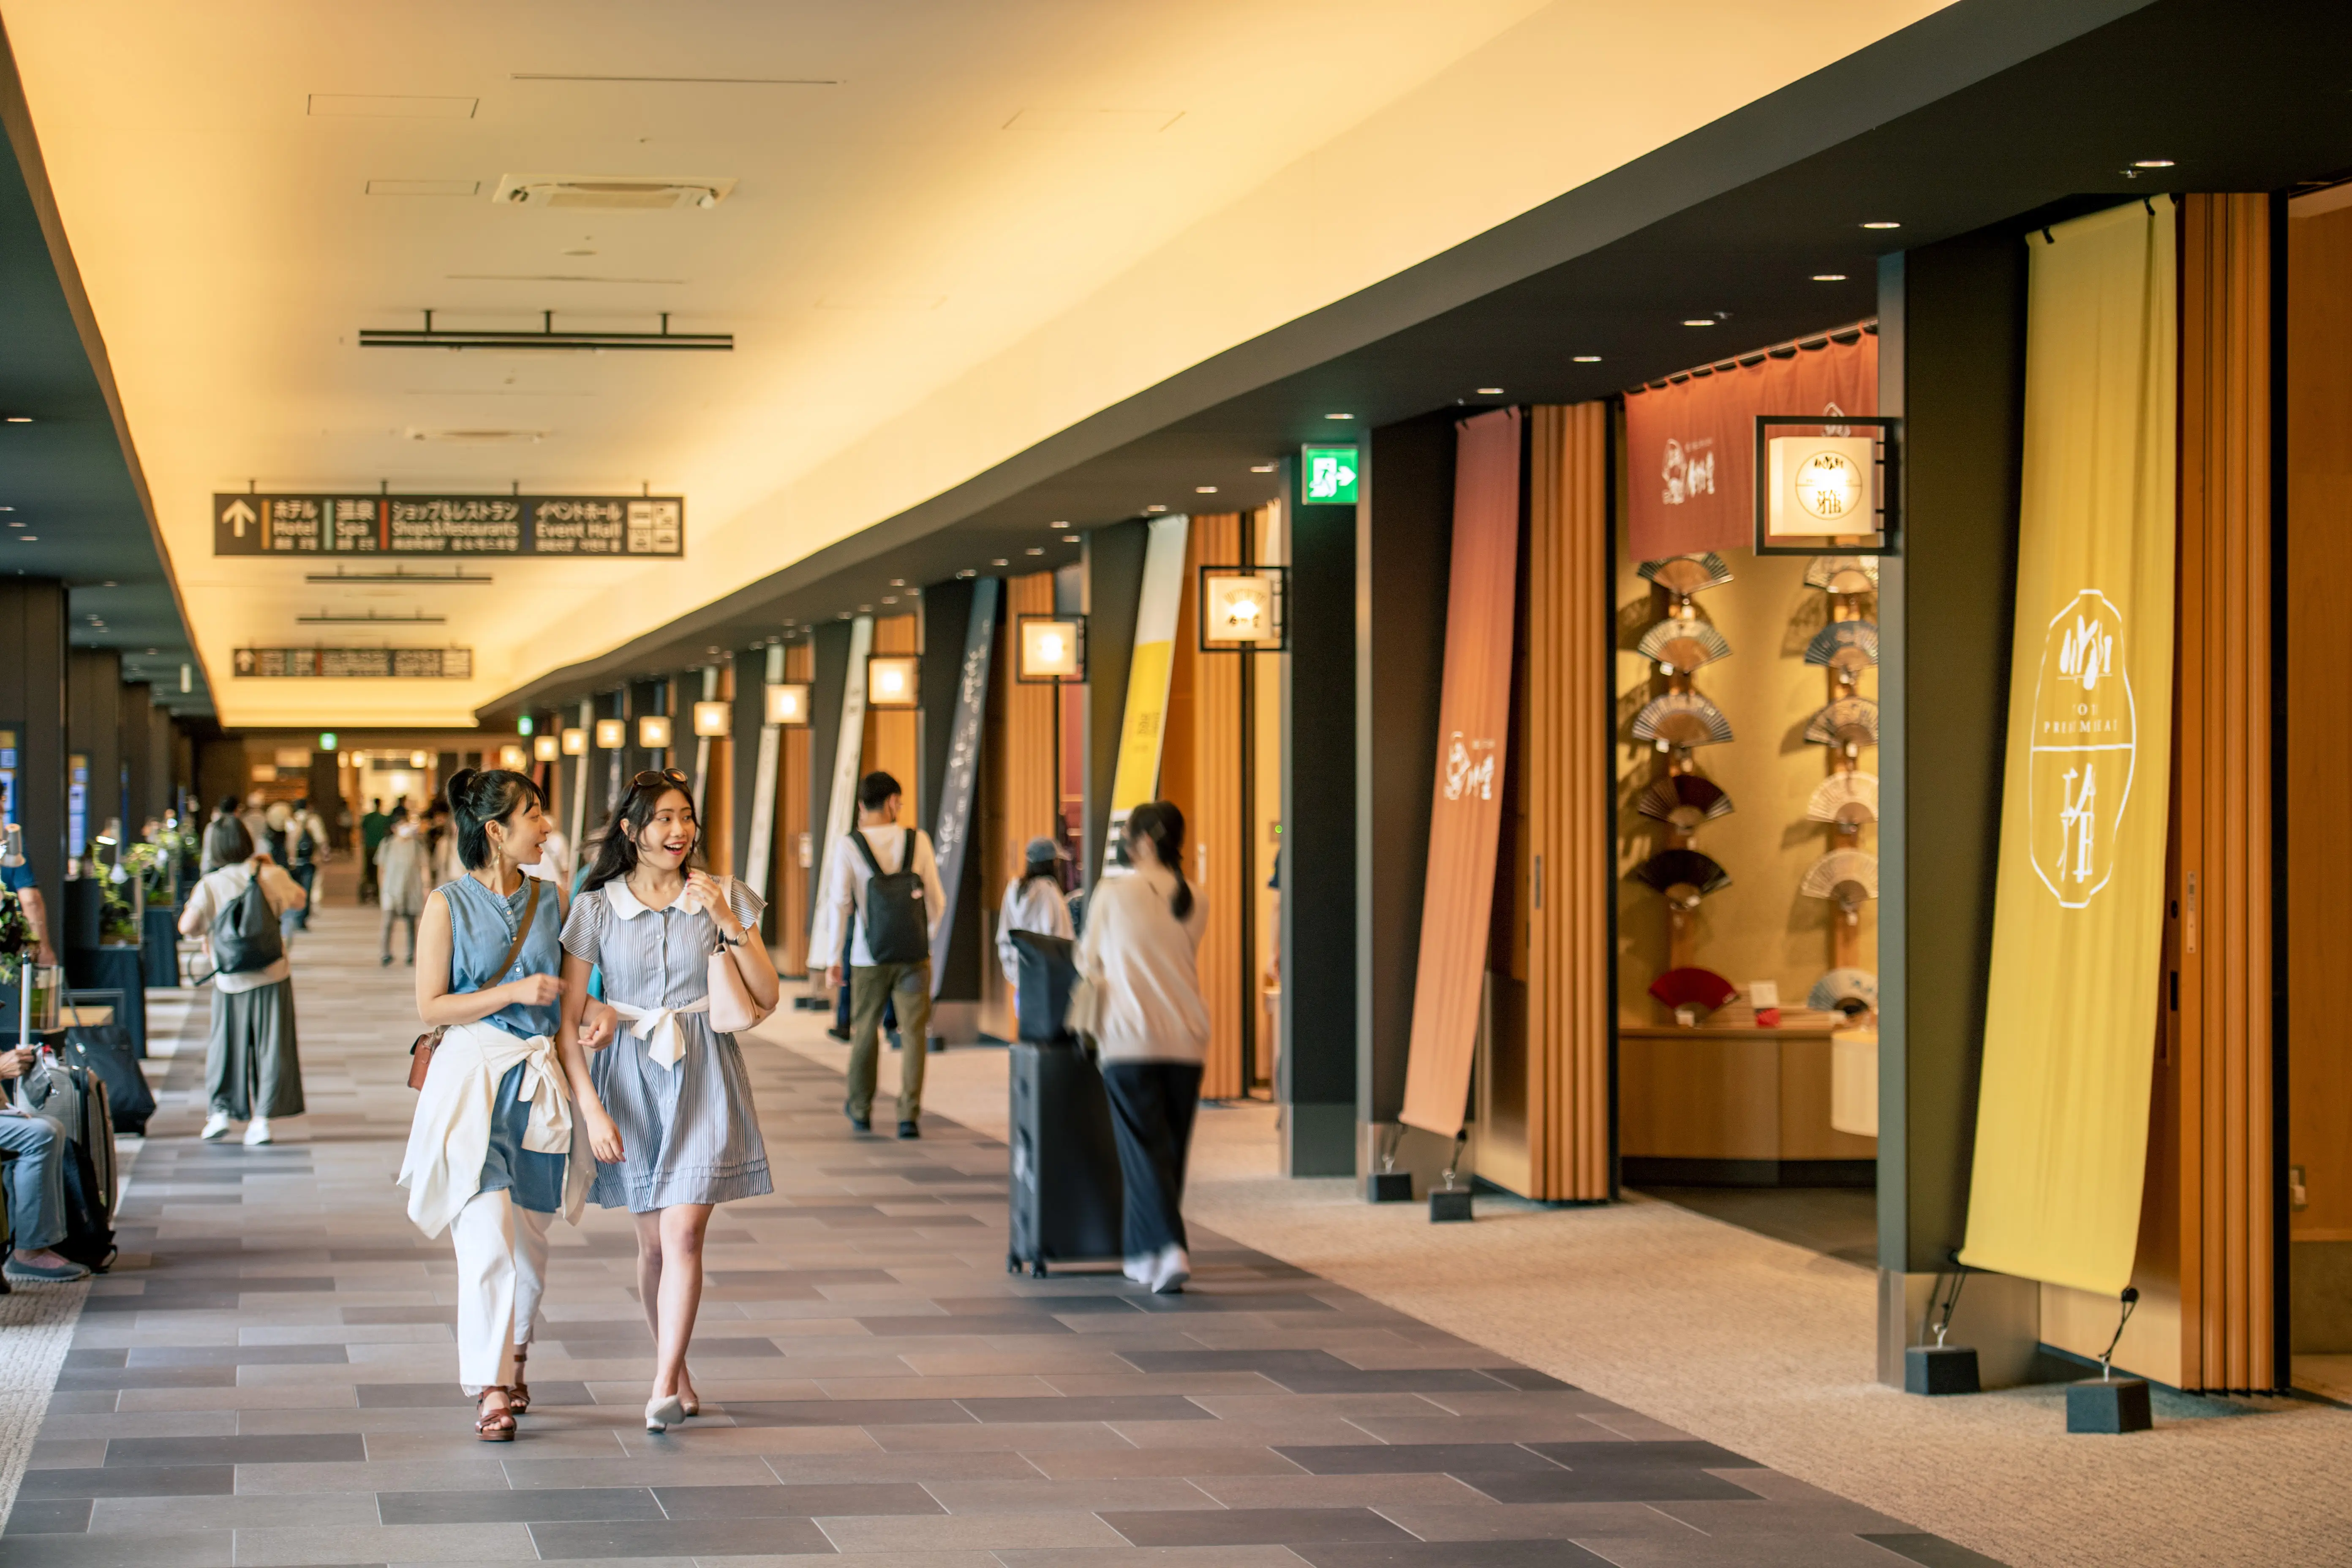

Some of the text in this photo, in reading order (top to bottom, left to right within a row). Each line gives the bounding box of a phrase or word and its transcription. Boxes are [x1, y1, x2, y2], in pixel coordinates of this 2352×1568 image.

[274, 500, 318, 519] ホテル
[336, 499, 375, 520] 温泉
[536, 501, 623, 521] イベントホール
[273, 519, 318, 536] Hotel
[336, 520, 369, 537] Spa
[536, 520, 584, 538] Event
[588, 520, 623, 538] Hall
